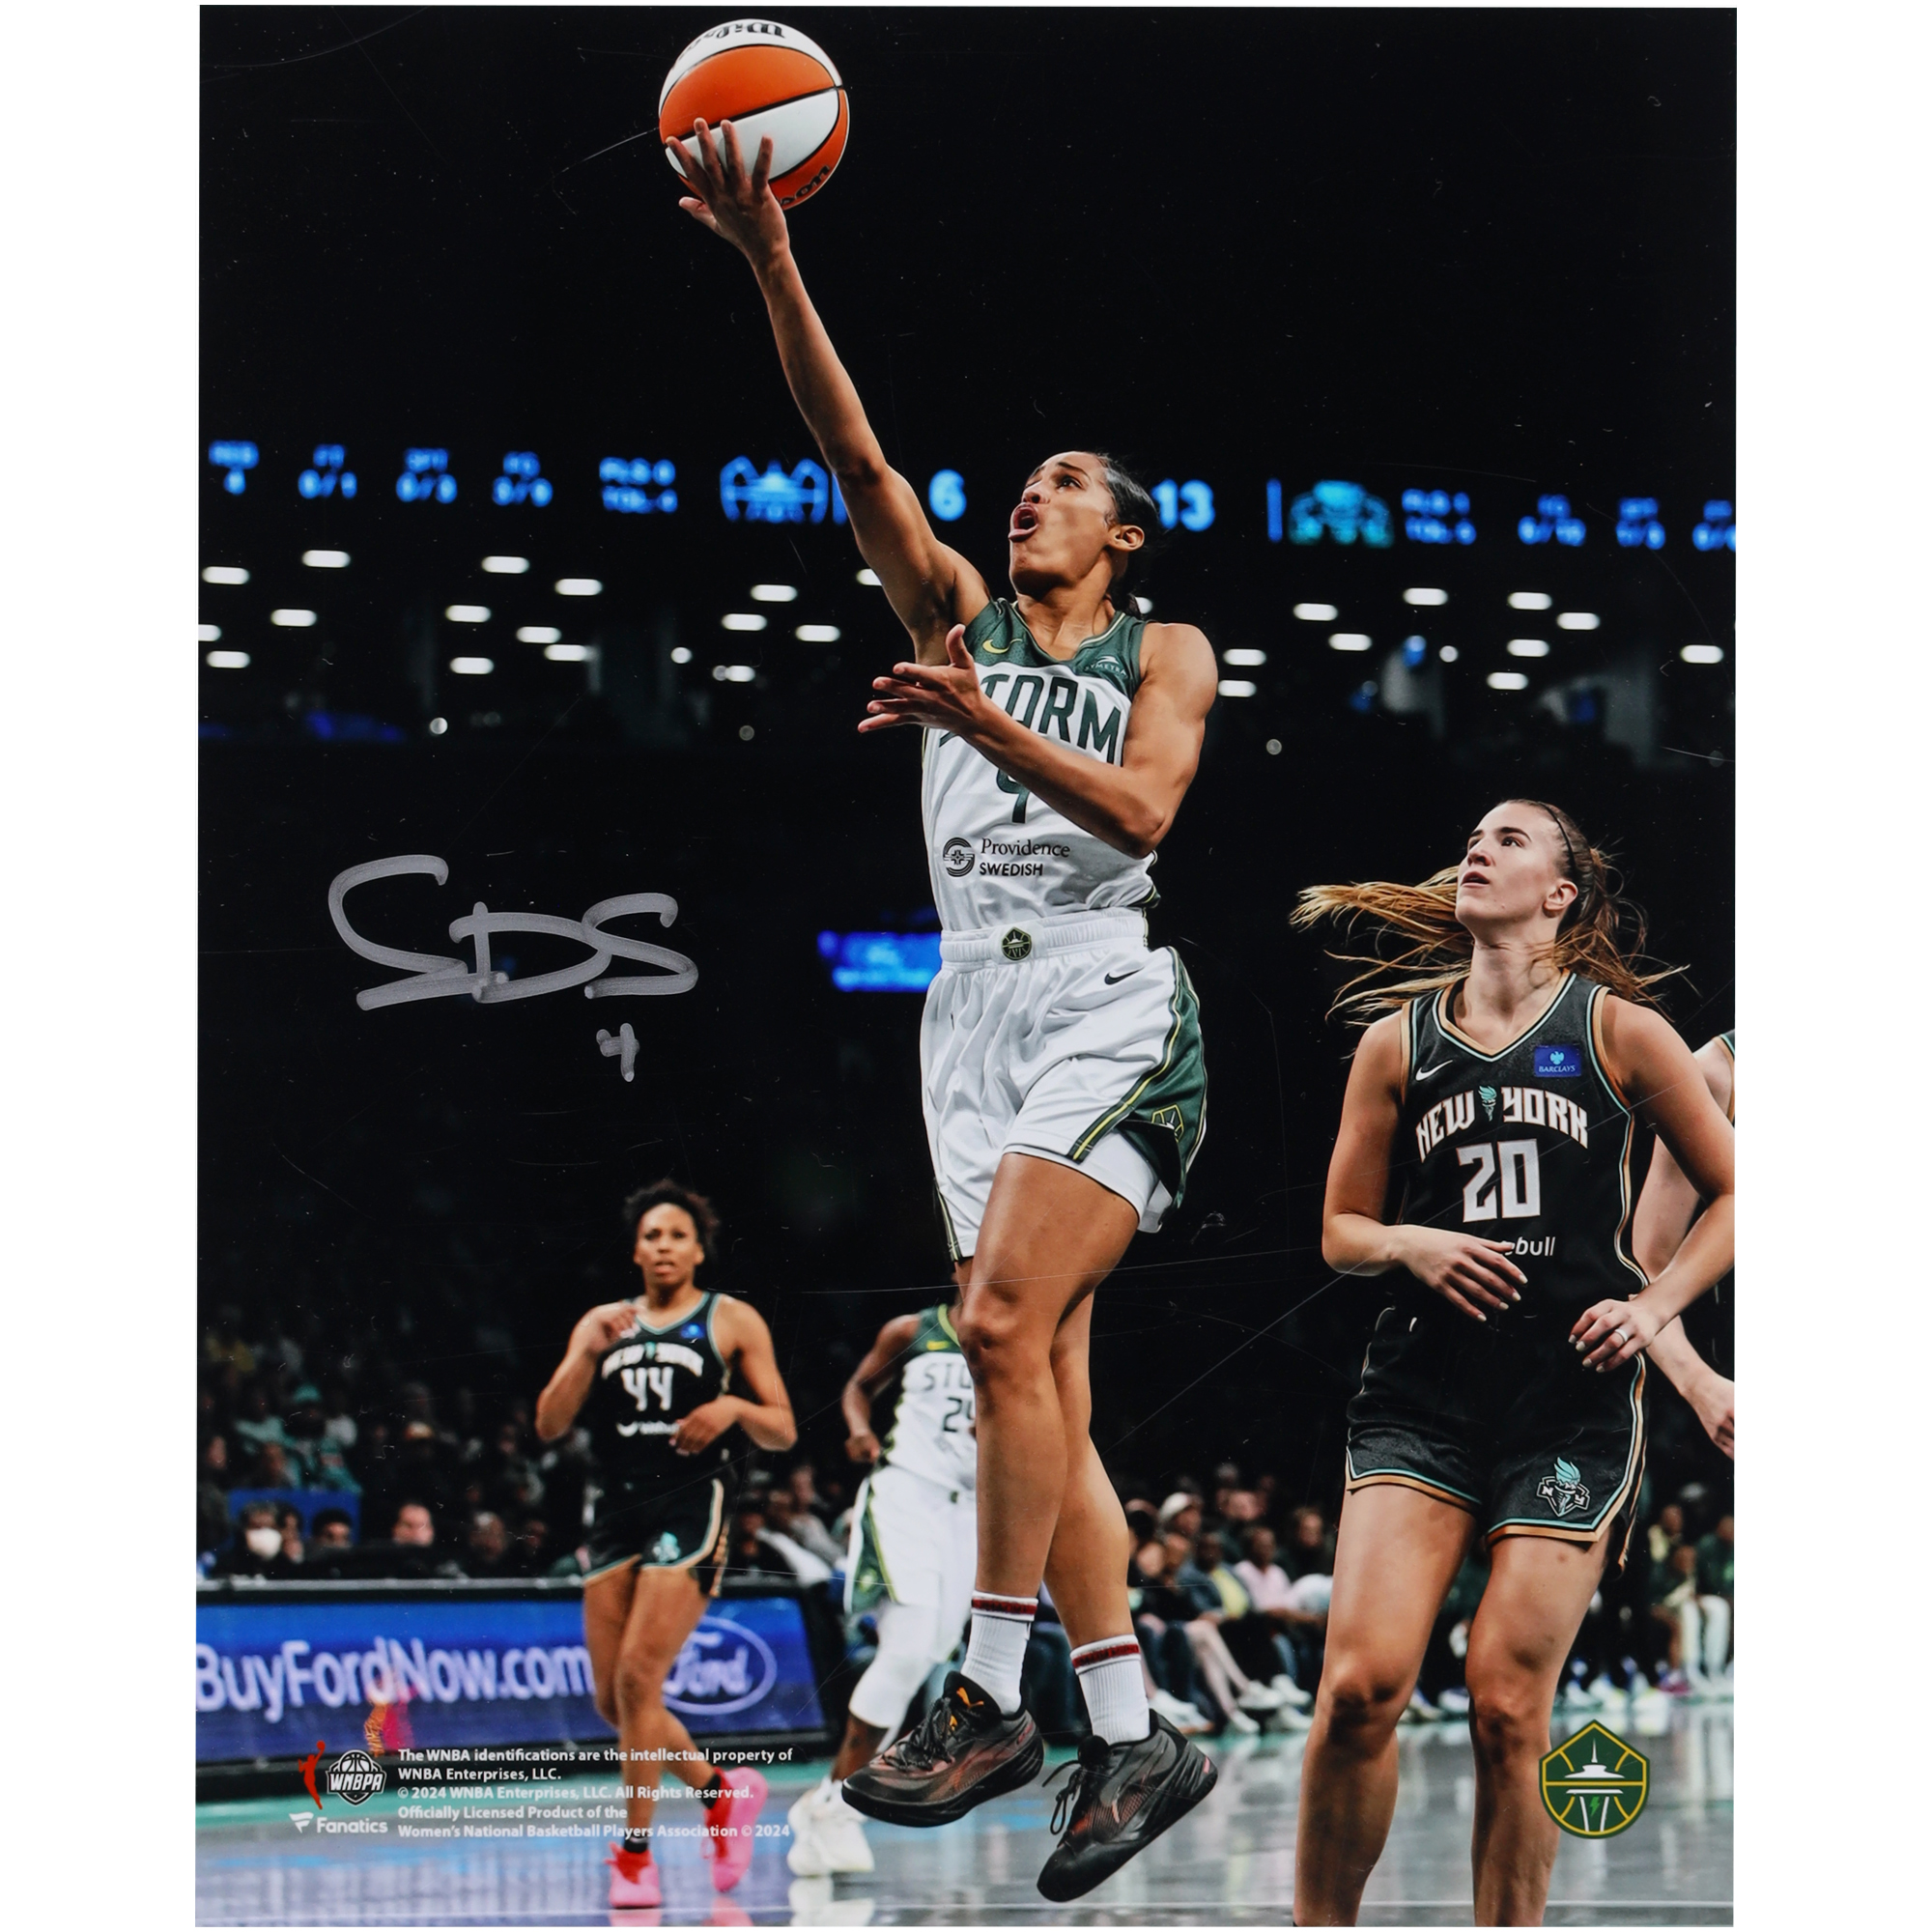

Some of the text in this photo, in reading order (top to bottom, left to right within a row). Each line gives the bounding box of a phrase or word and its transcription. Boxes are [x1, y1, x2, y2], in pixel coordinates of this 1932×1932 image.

[928, 469, 966, 521] 6
[1151, 478, 1215, 532] 13
[939, 673, 1122, 767] TORM
[980, 838, 1070, 858] Providence
[980, 863, 1043, 876] SWEDISH
[1539, 1065, 1576, 1073] BARCLAYS
[1415, 1087, 1588, 1163] NEW YORK
[1456, 1139, 1541, 1223] 20
[620, 1367, 674, 1411] 44
